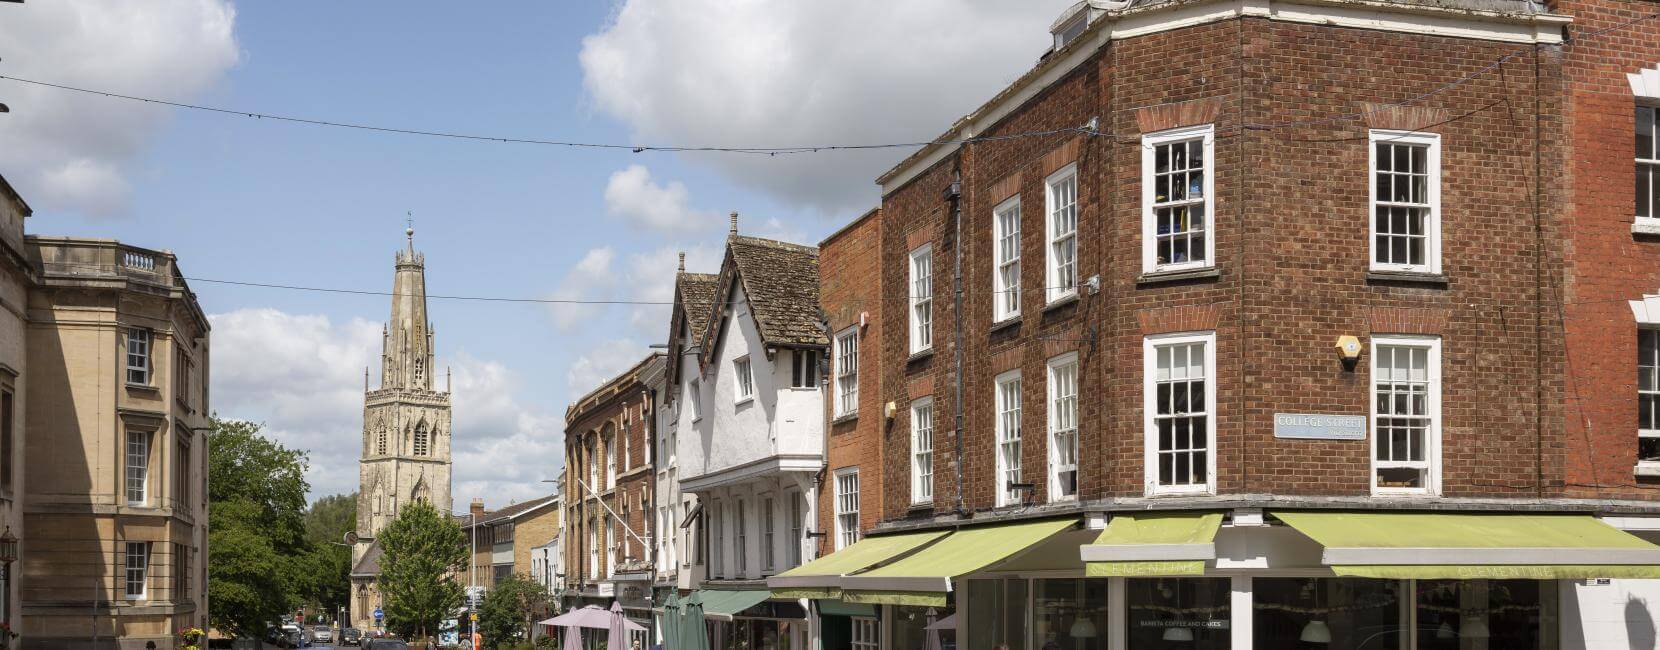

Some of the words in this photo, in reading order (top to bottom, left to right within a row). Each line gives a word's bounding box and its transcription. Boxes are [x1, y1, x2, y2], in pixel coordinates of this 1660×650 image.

[1278, 416, 1323, 427] COLLEGE
[1326, 417, 1361, 428] STREET
[1456, 566, 1553, 577] CLEMENTINE
